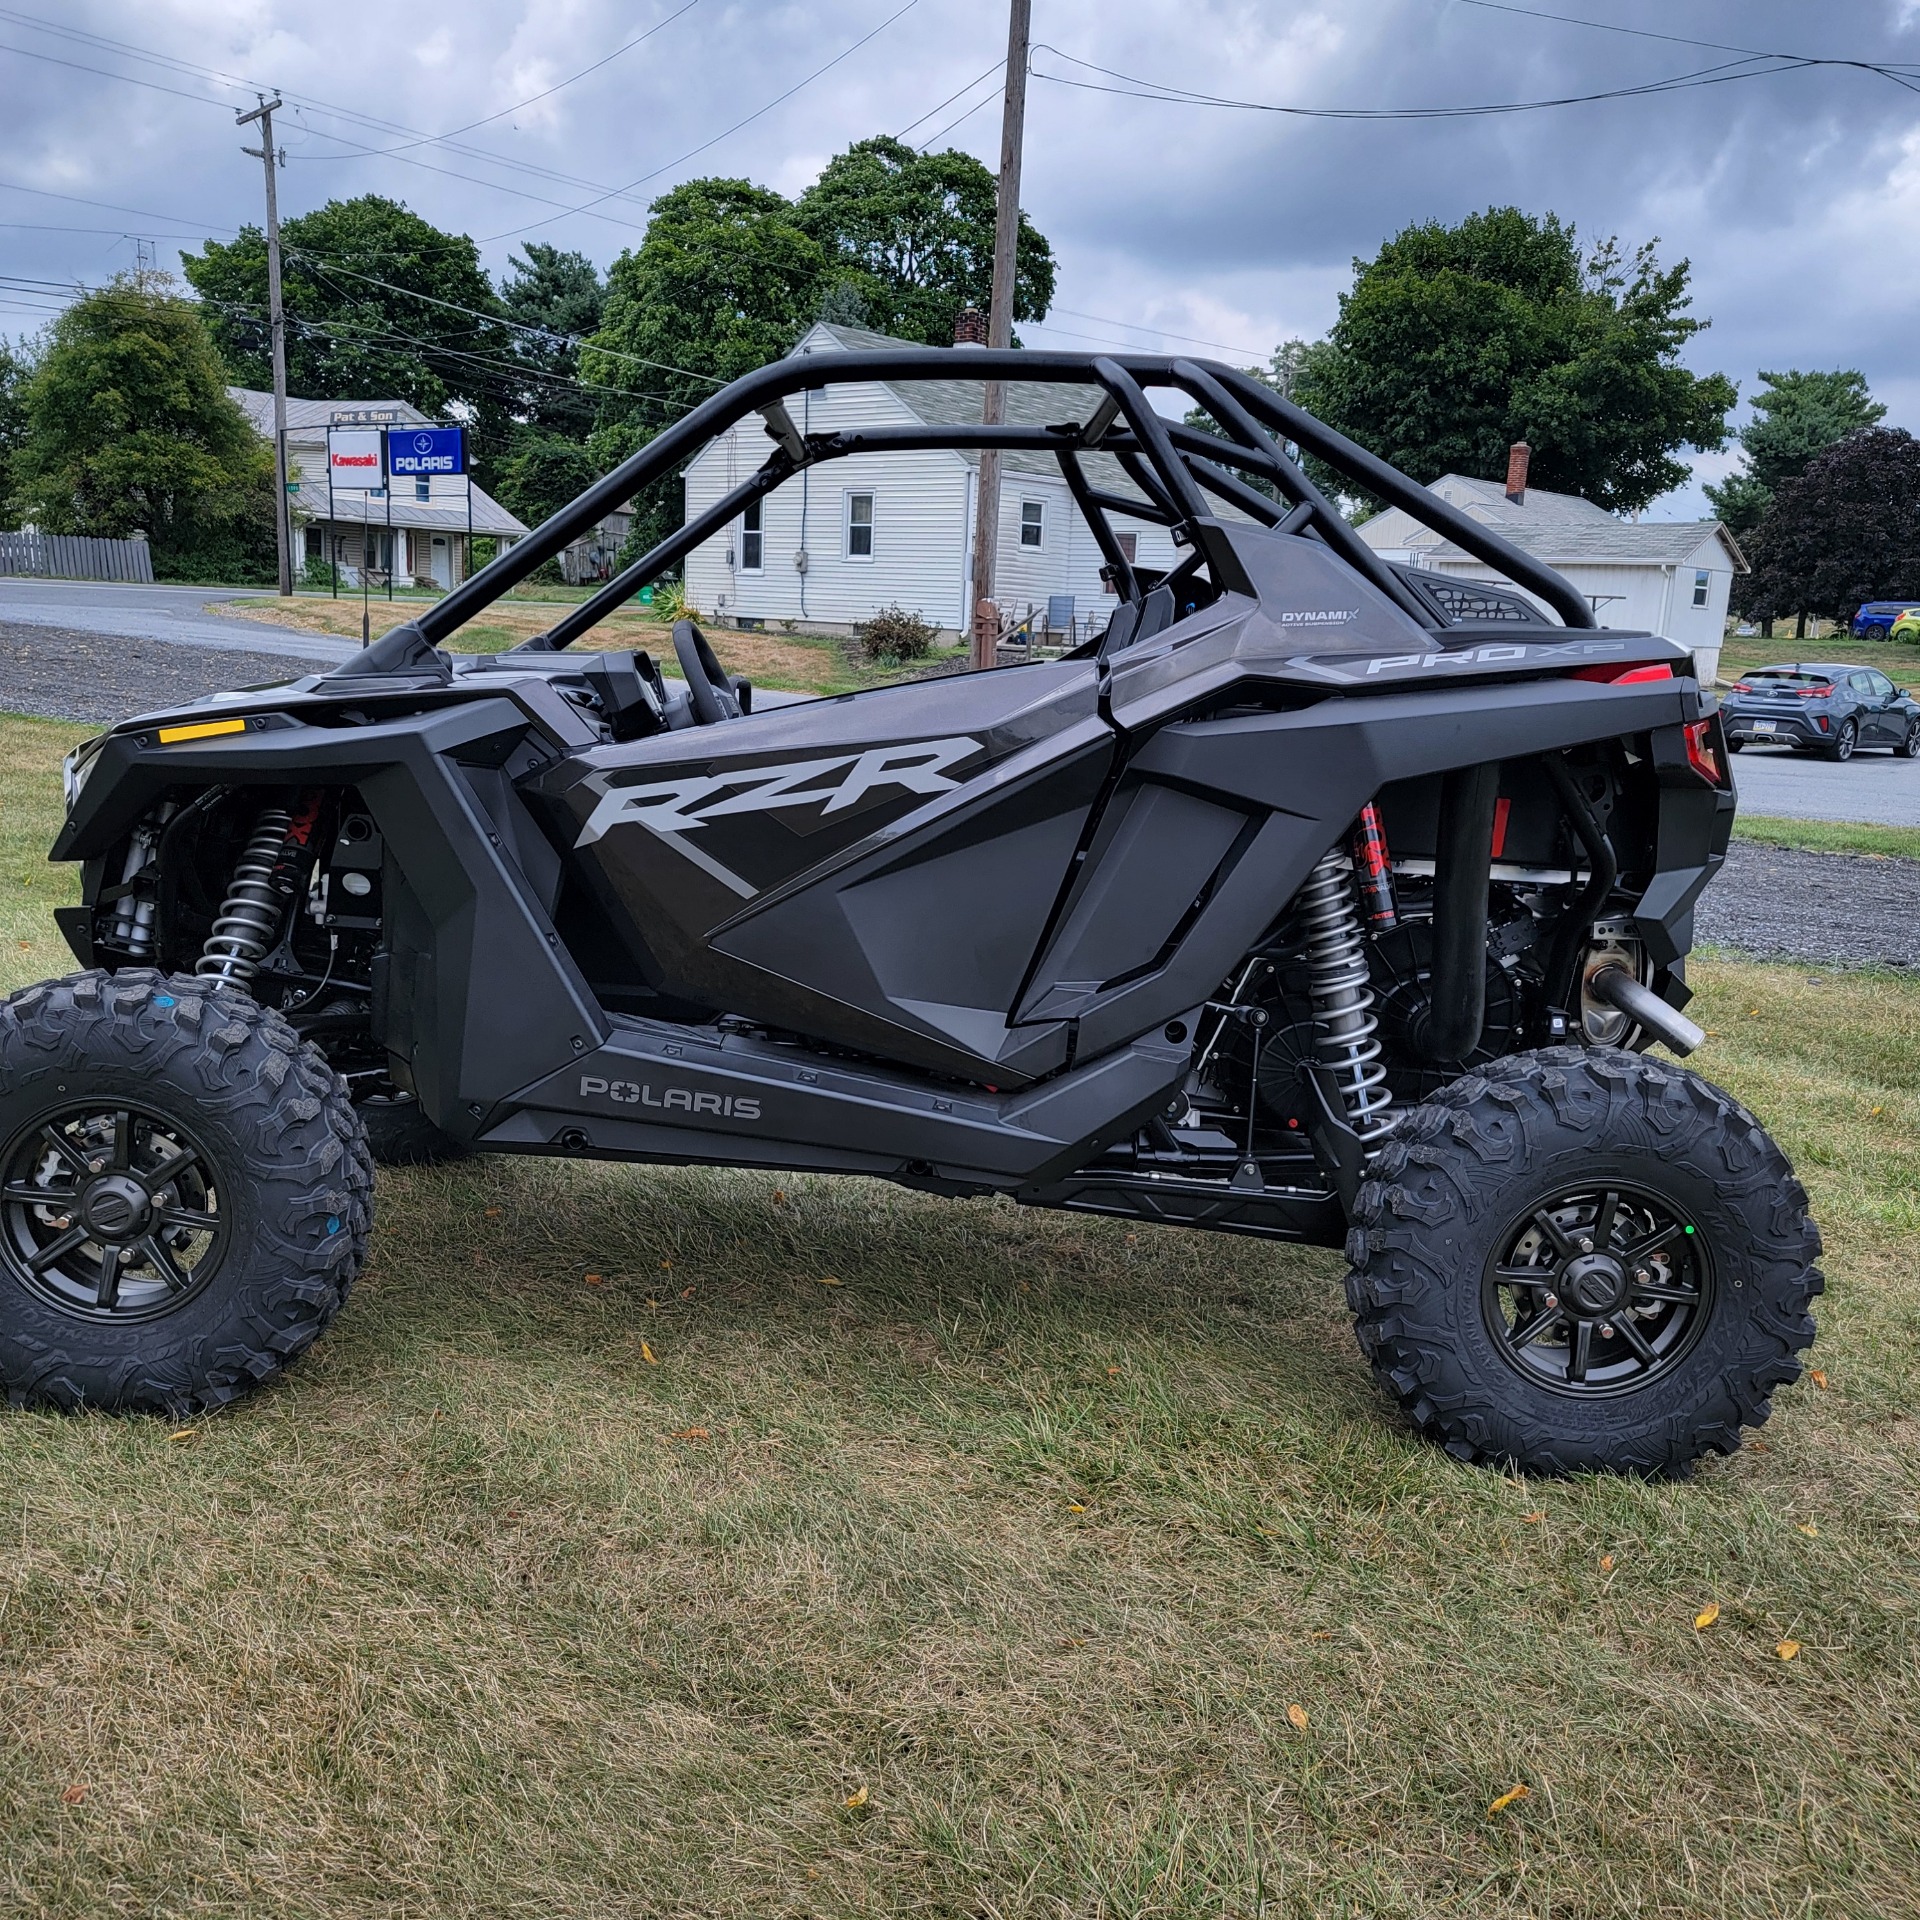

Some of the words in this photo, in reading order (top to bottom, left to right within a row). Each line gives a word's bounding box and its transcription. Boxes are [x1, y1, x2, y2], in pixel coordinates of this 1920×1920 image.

[333, 412, 353, 422] Pat
[357, 411, 367, 421] &
[370, 411, 393, 421] Son
[331, 453, 378, 468] Kawasaki
[395, 456, 453, 471] POLARIS
[1281, 608, 1360, 623] DYNAMIX
[1366, 646, 1527, 675] PRO
[1535, 643, 1625, 658] XP
[573, 736, 985, 849] RZR
[579, 1075, 762, 1120] POLARIS
